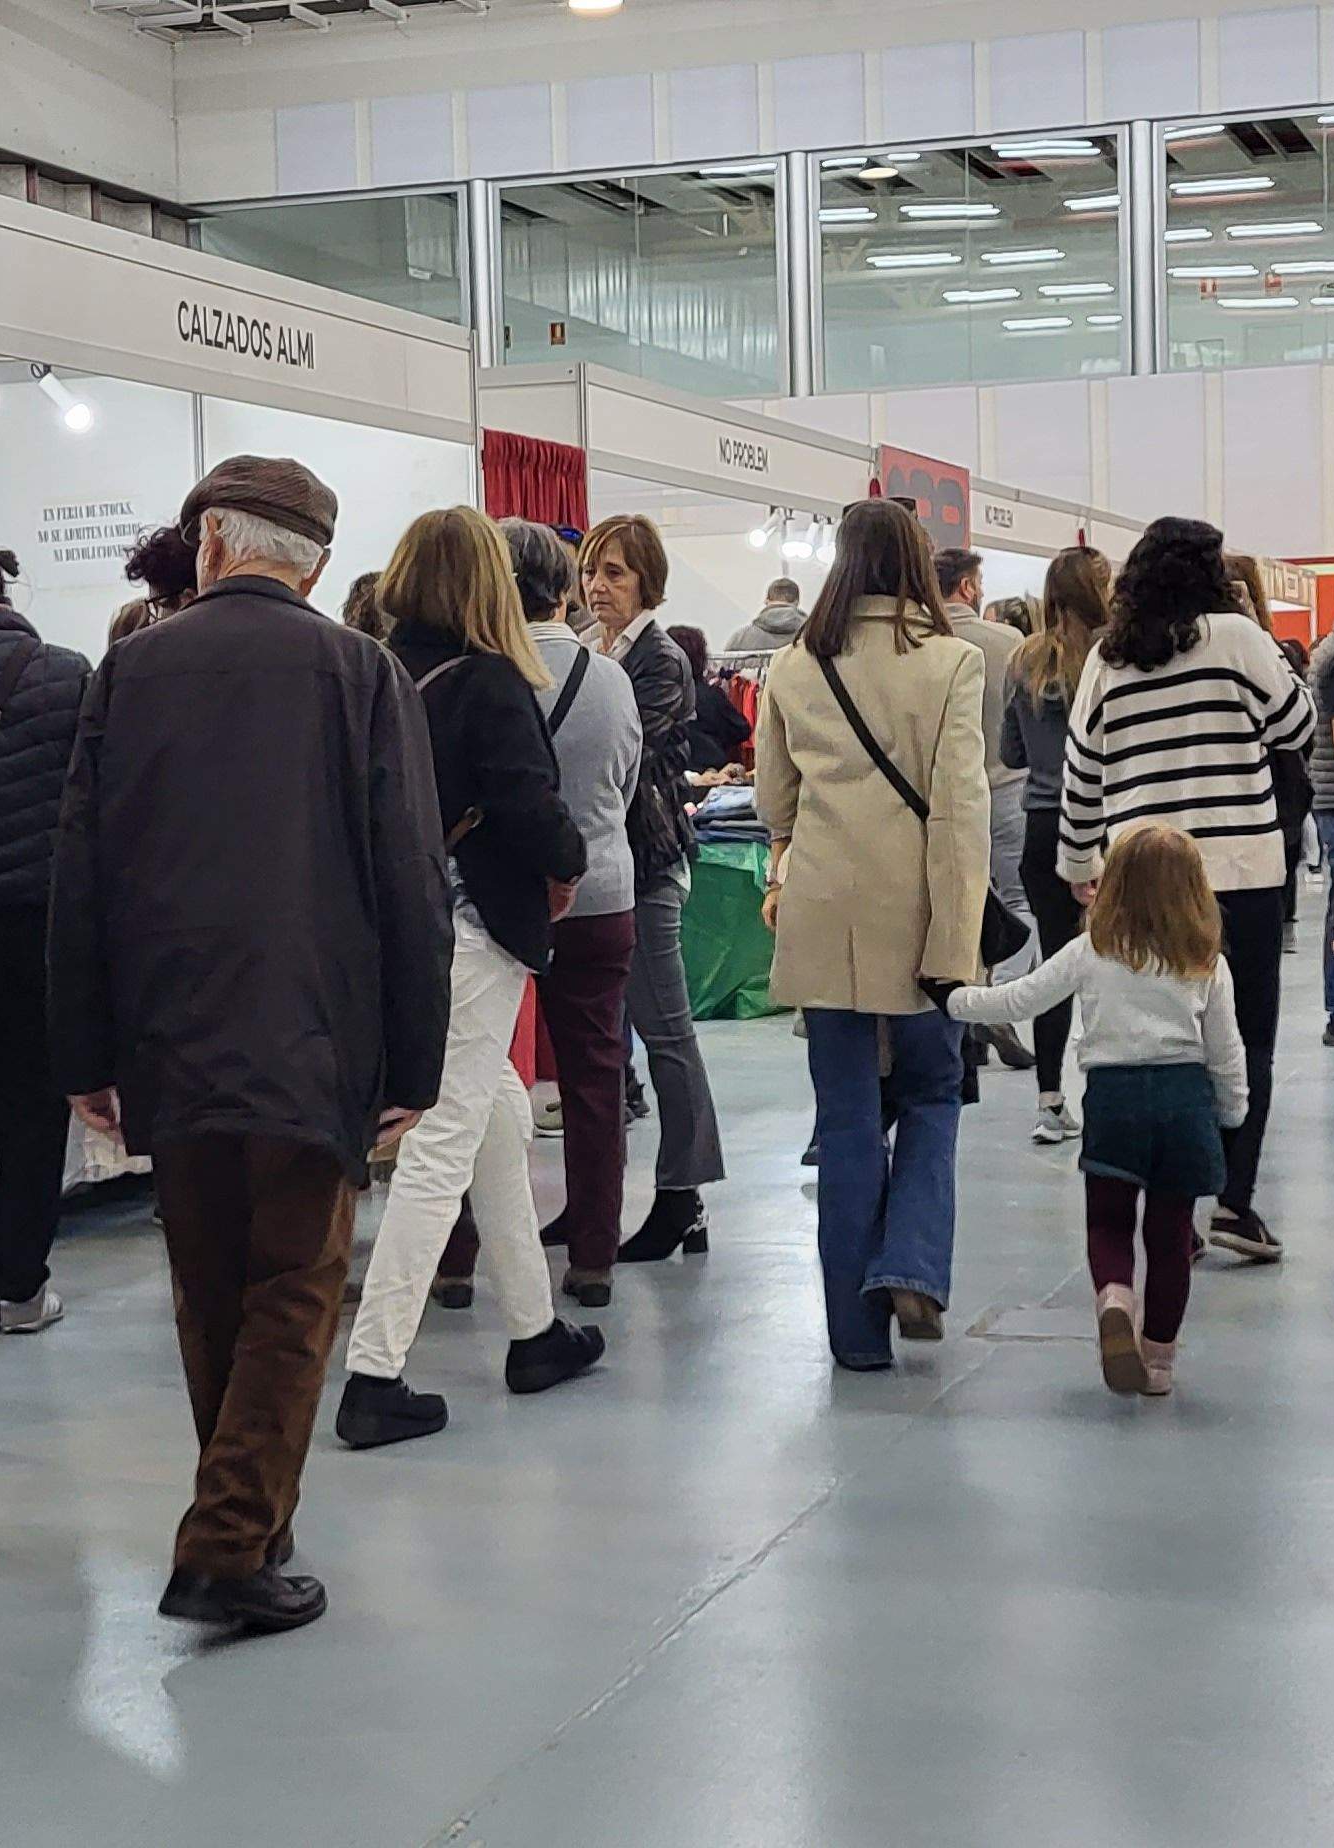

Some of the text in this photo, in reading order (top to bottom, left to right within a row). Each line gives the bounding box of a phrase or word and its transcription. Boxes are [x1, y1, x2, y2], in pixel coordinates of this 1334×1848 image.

[177, 300, 315, 370] CALZADOS ALMI
[719, 436, 770, 474] NO PROBLEM
[37, 530, 50, 544] NO
[51, 528, 62, 543] SE
[64, 525, 102, 541] ADMITEN
[65, 544, 126, 561] DEVOLUCIONE
